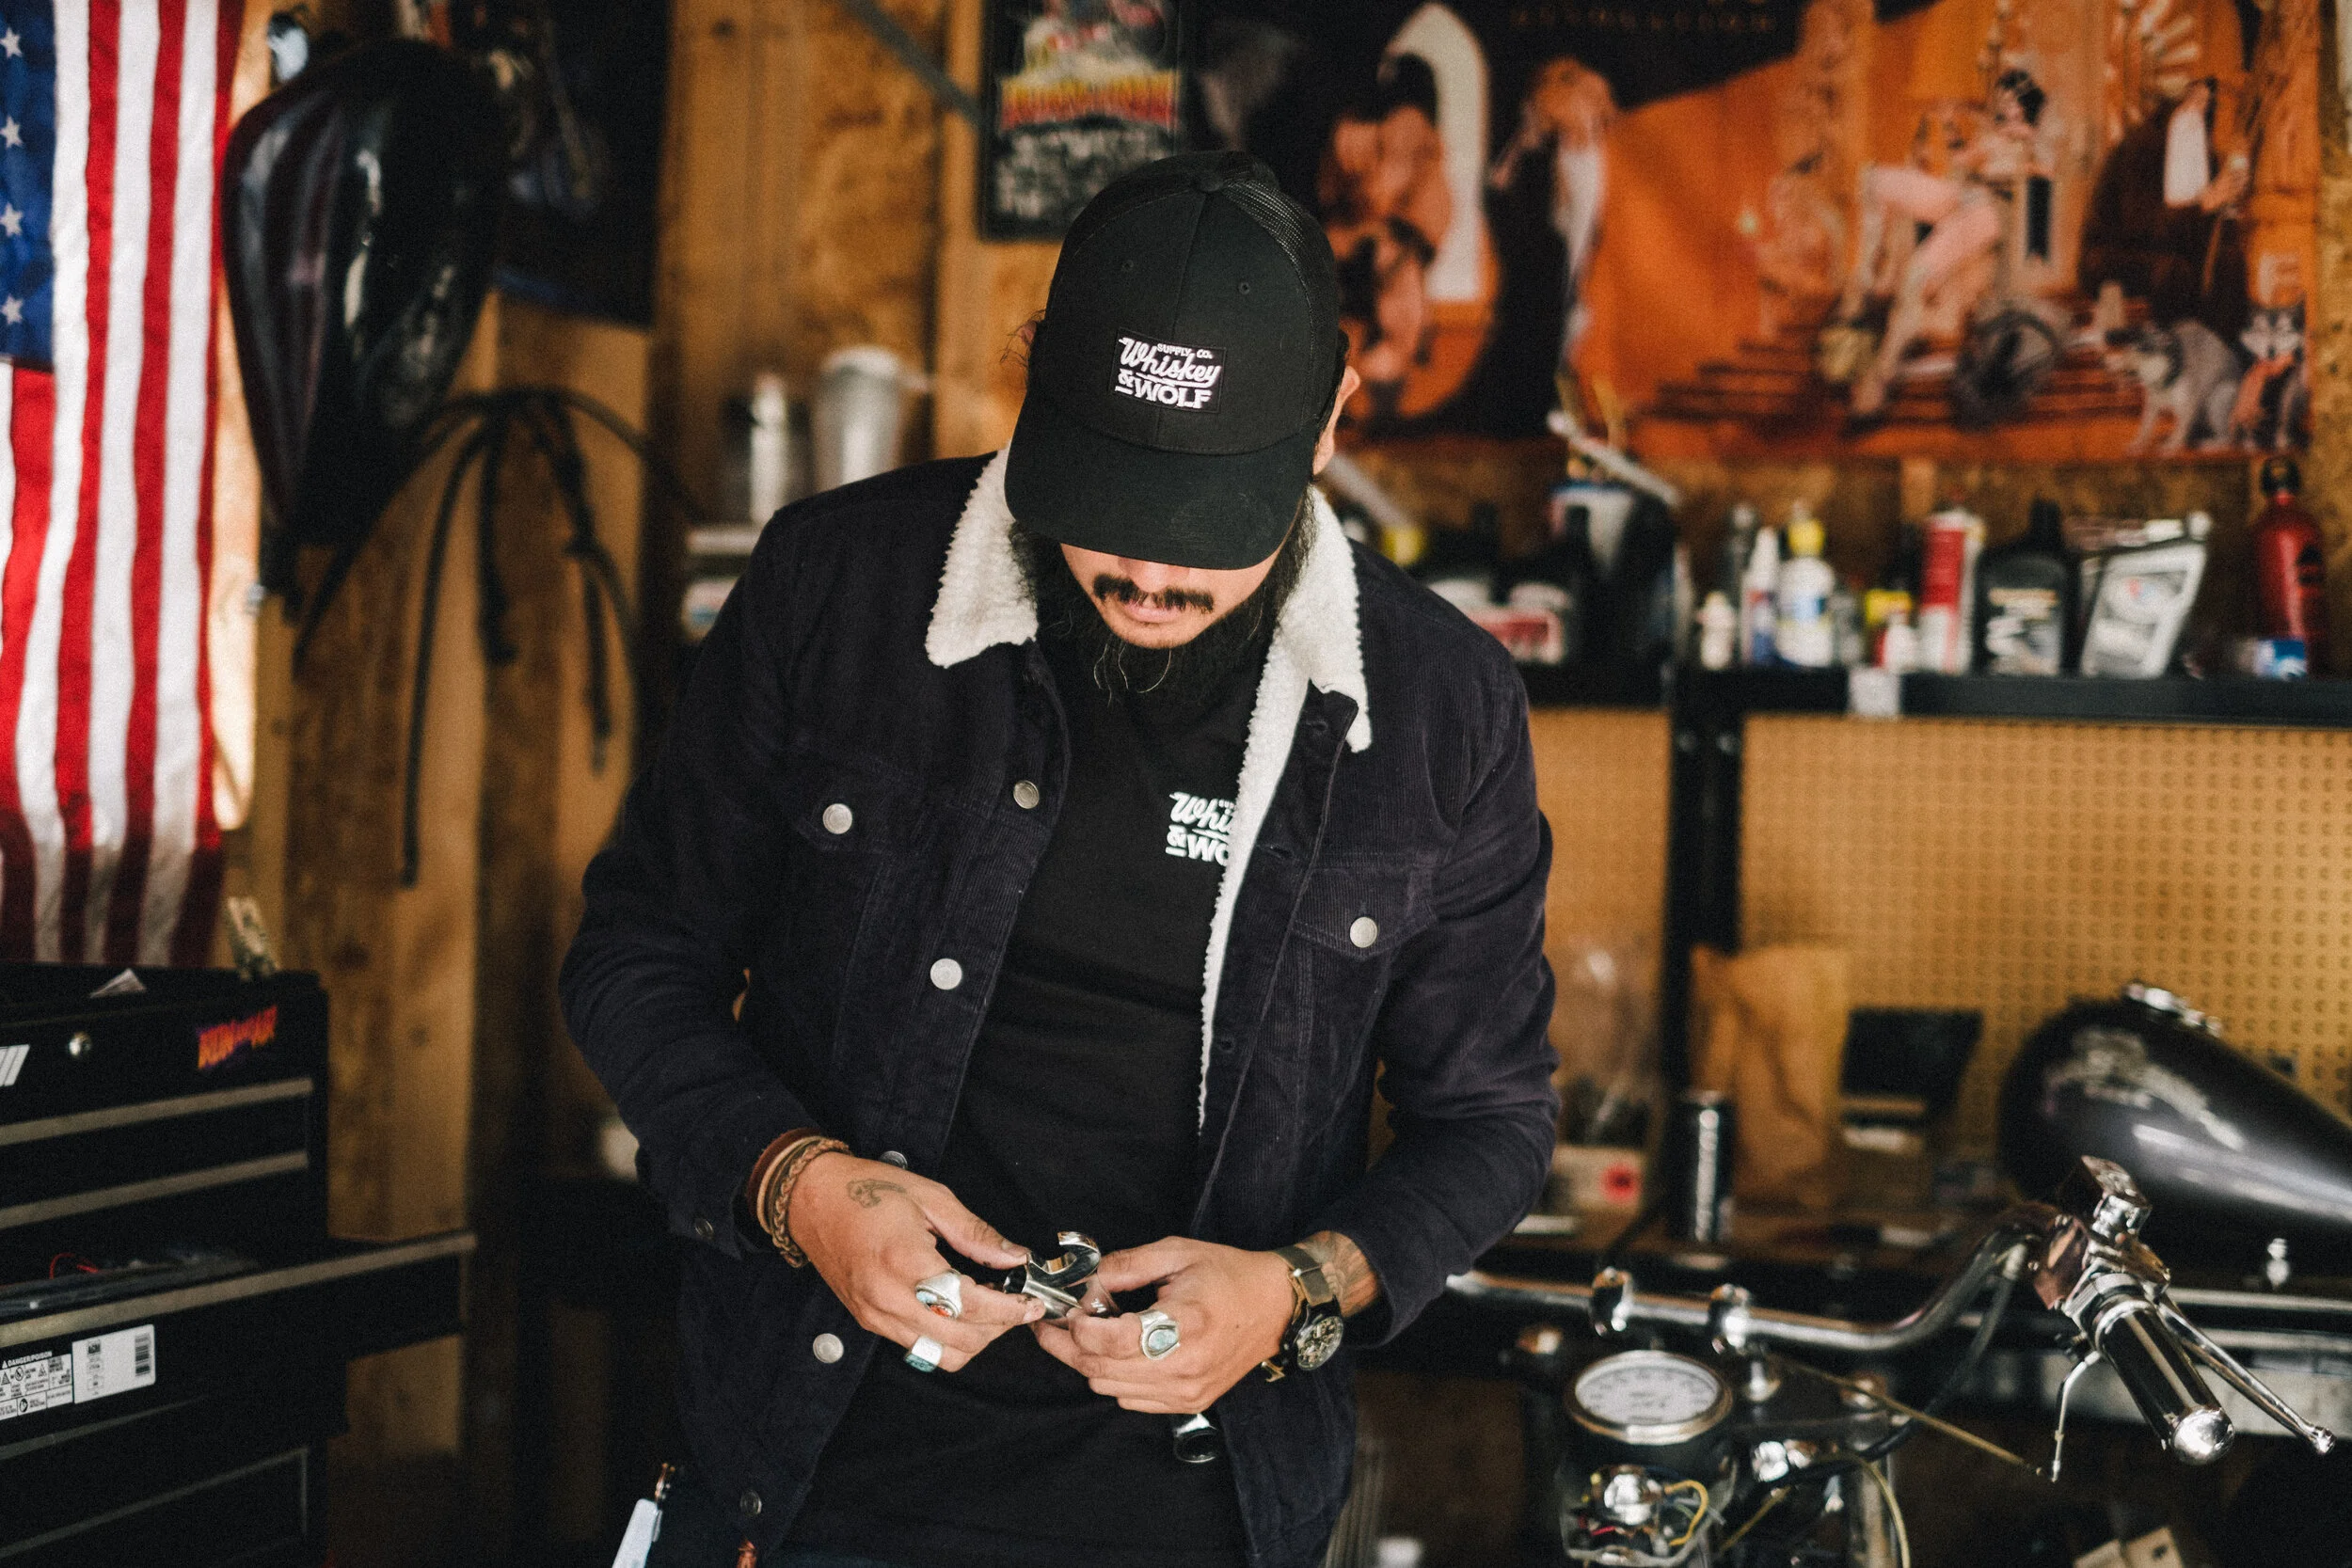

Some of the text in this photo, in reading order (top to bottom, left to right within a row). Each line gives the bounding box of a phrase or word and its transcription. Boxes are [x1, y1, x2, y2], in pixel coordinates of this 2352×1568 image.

[1118, 337, 1222, 388] Whiskey
[1156, 342, 1193, 357] SUPPLY
[1168, 791, 1233, 833] Whi
